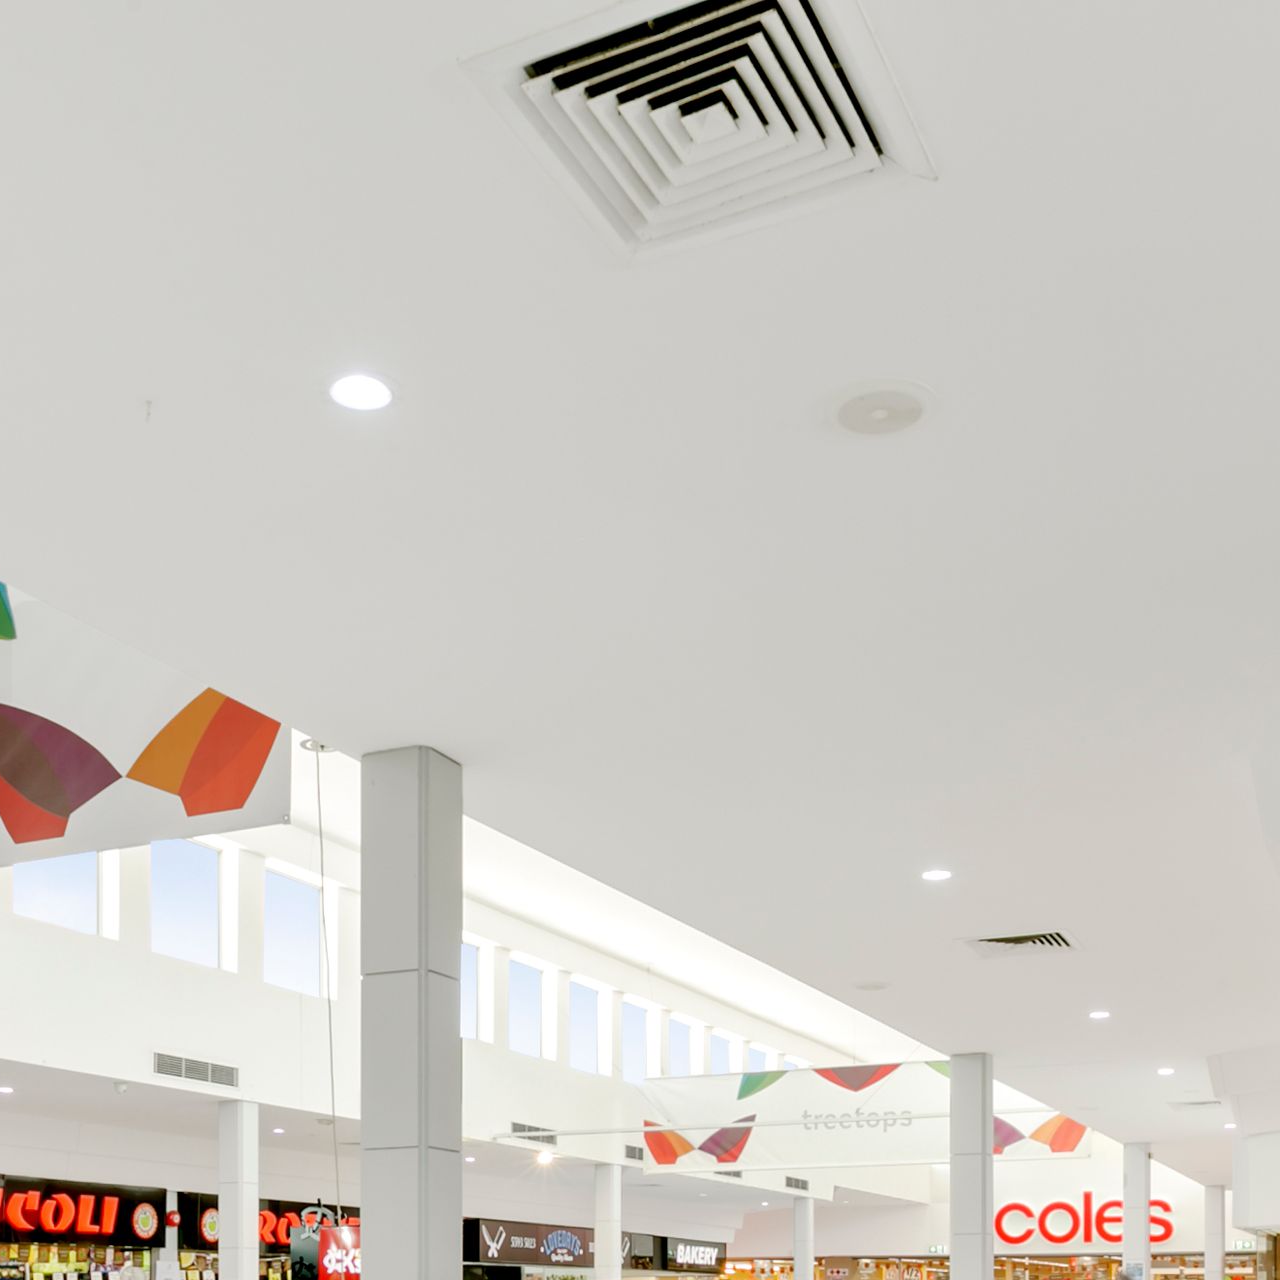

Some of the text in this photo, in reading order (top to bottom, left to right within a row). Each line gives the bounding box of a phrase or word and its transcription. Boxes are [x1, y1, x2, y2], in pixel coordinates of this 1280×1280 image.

[801, 1107, 913, 1133] treetops
[993, 1190, 1175, 1246] coles
[676, 1243, 719, 1266] BAKERY
